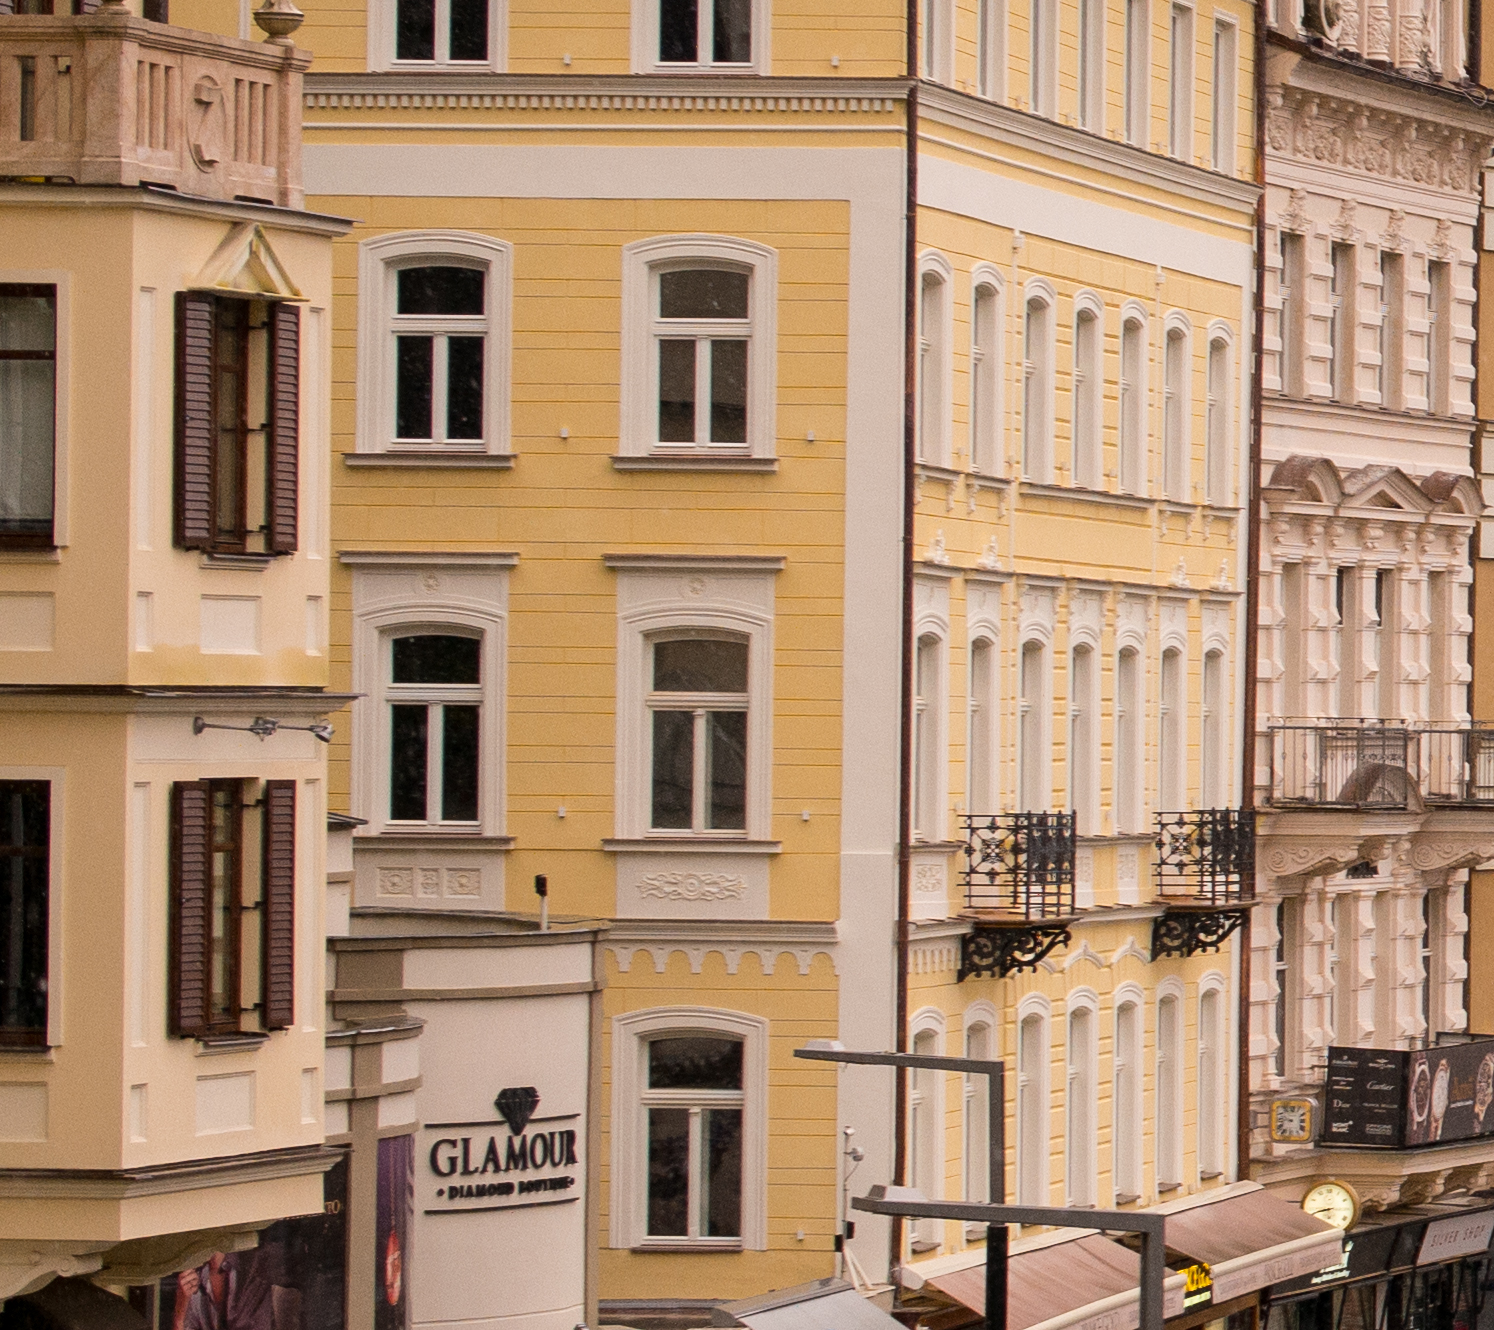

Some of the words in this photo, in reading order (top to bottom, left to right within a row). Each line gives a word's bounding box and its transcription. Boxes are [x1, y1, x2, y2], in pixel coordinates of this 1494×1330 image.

[430, 1129, 579, 1177] GLAMOUR
[448, 1181, 515, 1200] DIAMOND
[1430, 1230, 1458, 1247] SILVER
[1462, 1224, 1486, 1242] SHOP
